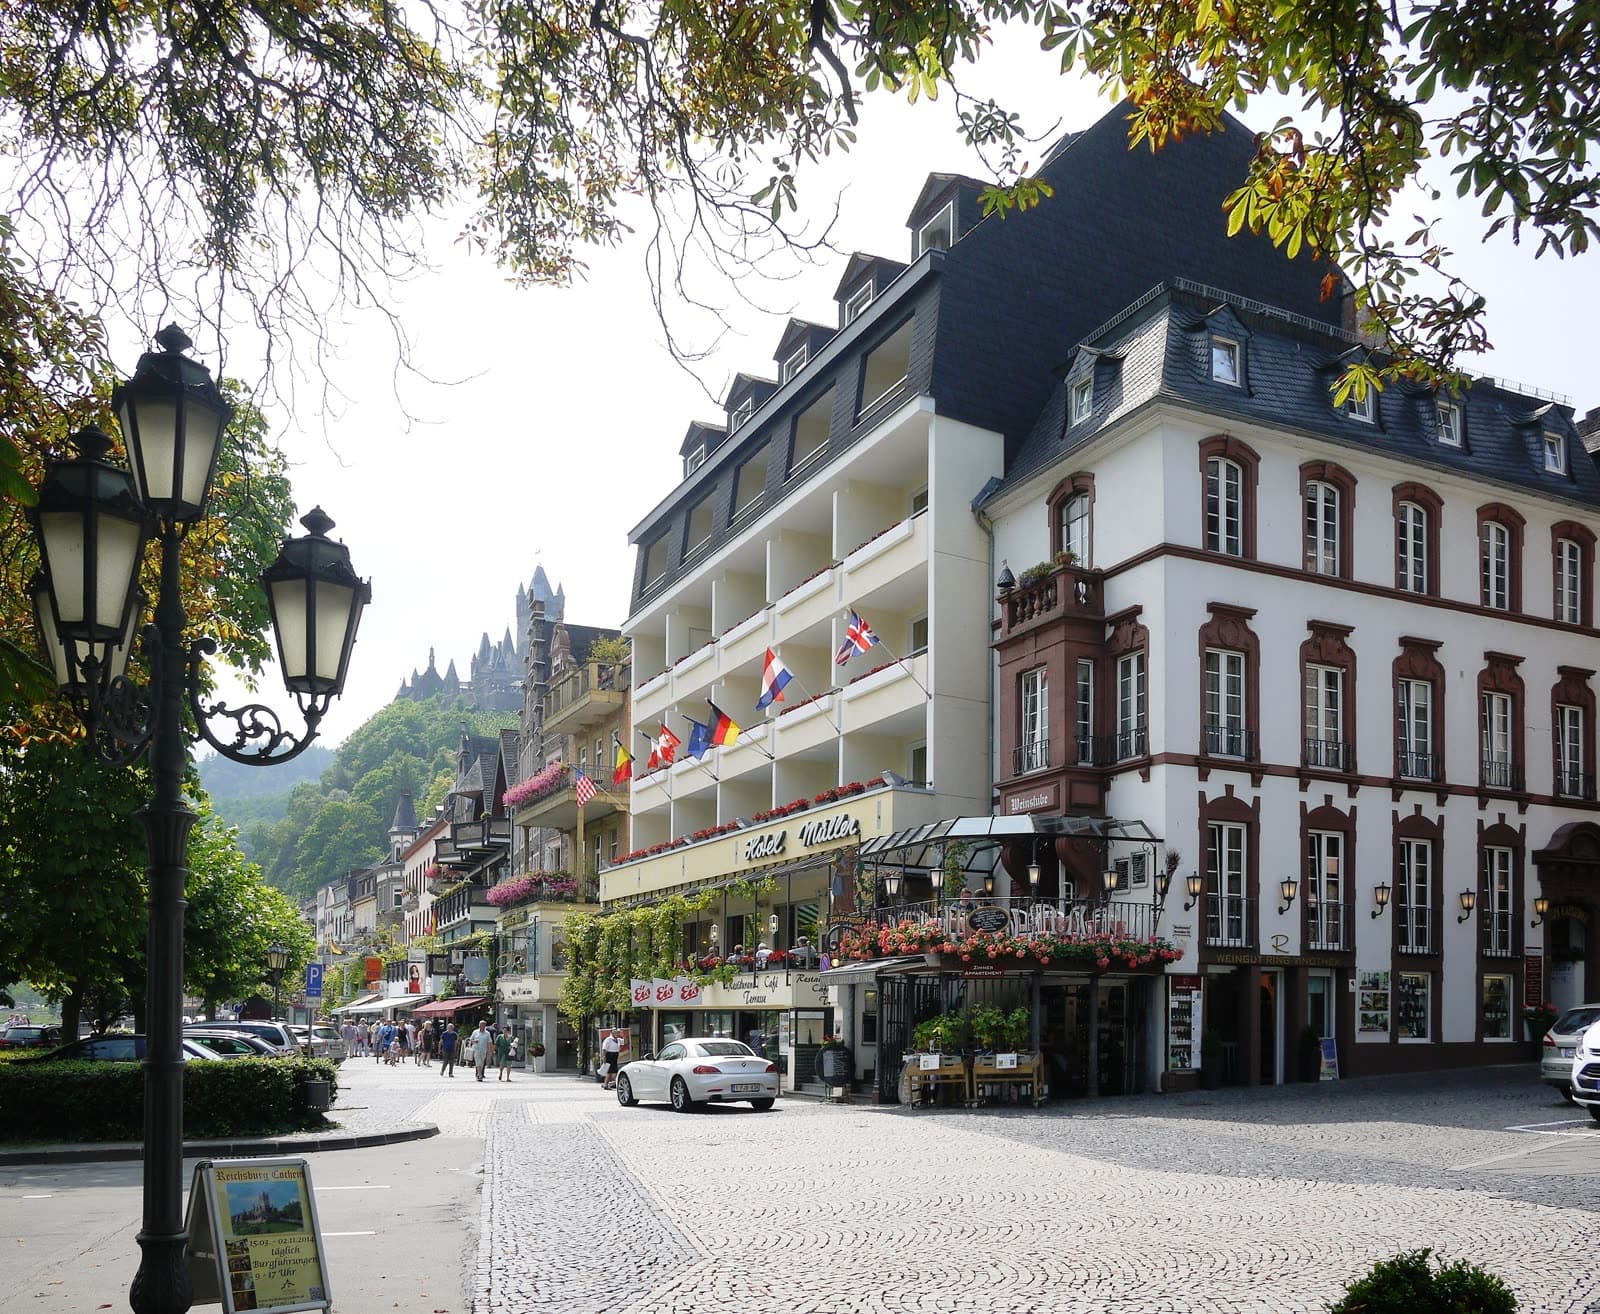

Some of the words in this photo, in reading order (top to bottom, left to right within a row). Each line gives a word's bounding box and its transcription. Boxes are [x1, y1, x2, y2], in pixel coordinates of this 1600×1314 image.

[1011, 793, 1048, 811] Weinstube
[744, 830, 785, 860] Hotel
[798, 815, 859, 848] Müller
[1216, 953, 1262, 964] WEINGUT
[1266, 955, 1290, 965] RING
[310, 967, 320, 985] P
[634, 984, 651, 1002] Eis
[656, 984, 674, 1002] Eis
[680, 982, 699, 1001] Eis
[216, 1170, 270, 1182] Reichsburg
[271, 1246, 300, 1257] täglich
[252, 1256, 319, 1270] Burgführungen
[268, 1271, 276, 1279] 17
[278, 1268, 296, 1277] Uhr
